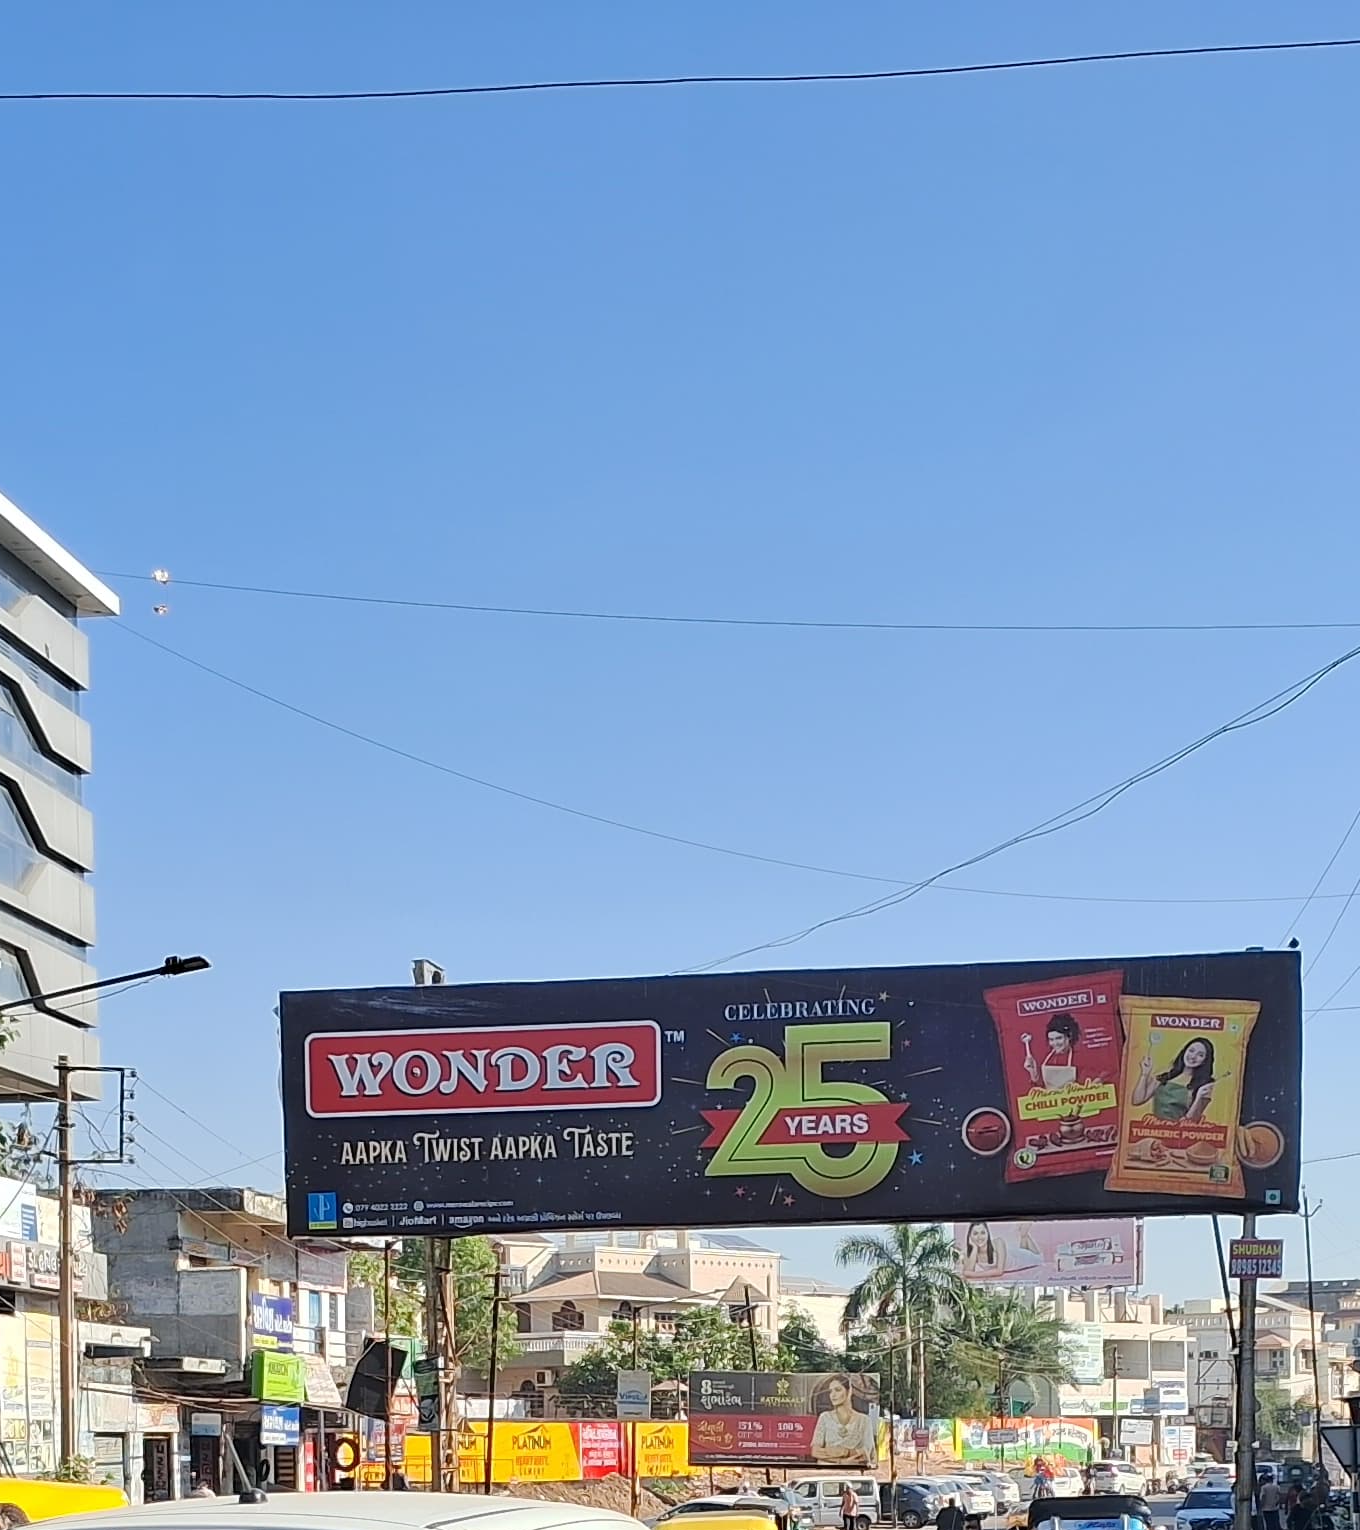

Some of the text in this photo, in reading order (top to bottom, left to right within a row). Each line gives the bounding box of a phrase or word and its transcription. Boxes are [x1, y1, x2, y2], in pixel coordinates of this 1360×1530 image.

[723, 998, 876, 1022] CELEBRATING
[1021, 993, 1090, 1013] WONDER
[1155, 1015, 1222, 1030] WONDER
[327, 1030, 685, 1098] WONDER TM
[705, 1021, 900, 1199] 25
[1024, 1091, 1110, 1112] CHILLI POWDER
[784, 1113, 869, 1137] YEARS
[1131, 1127, 1225, 1142] TURMERIC POWDER
[340, 1140, 408, 1166] AAPKA
[489, 1134, 558, 1161] AAPKA
[1232, 1243, 1282, 1256] SHUBHAM
[1258, 1258, 1282, 1275] 12345
[512, 1435, 552, 1450] PLATINUM
[641, 1435, 675, 1449] PLATINUM
